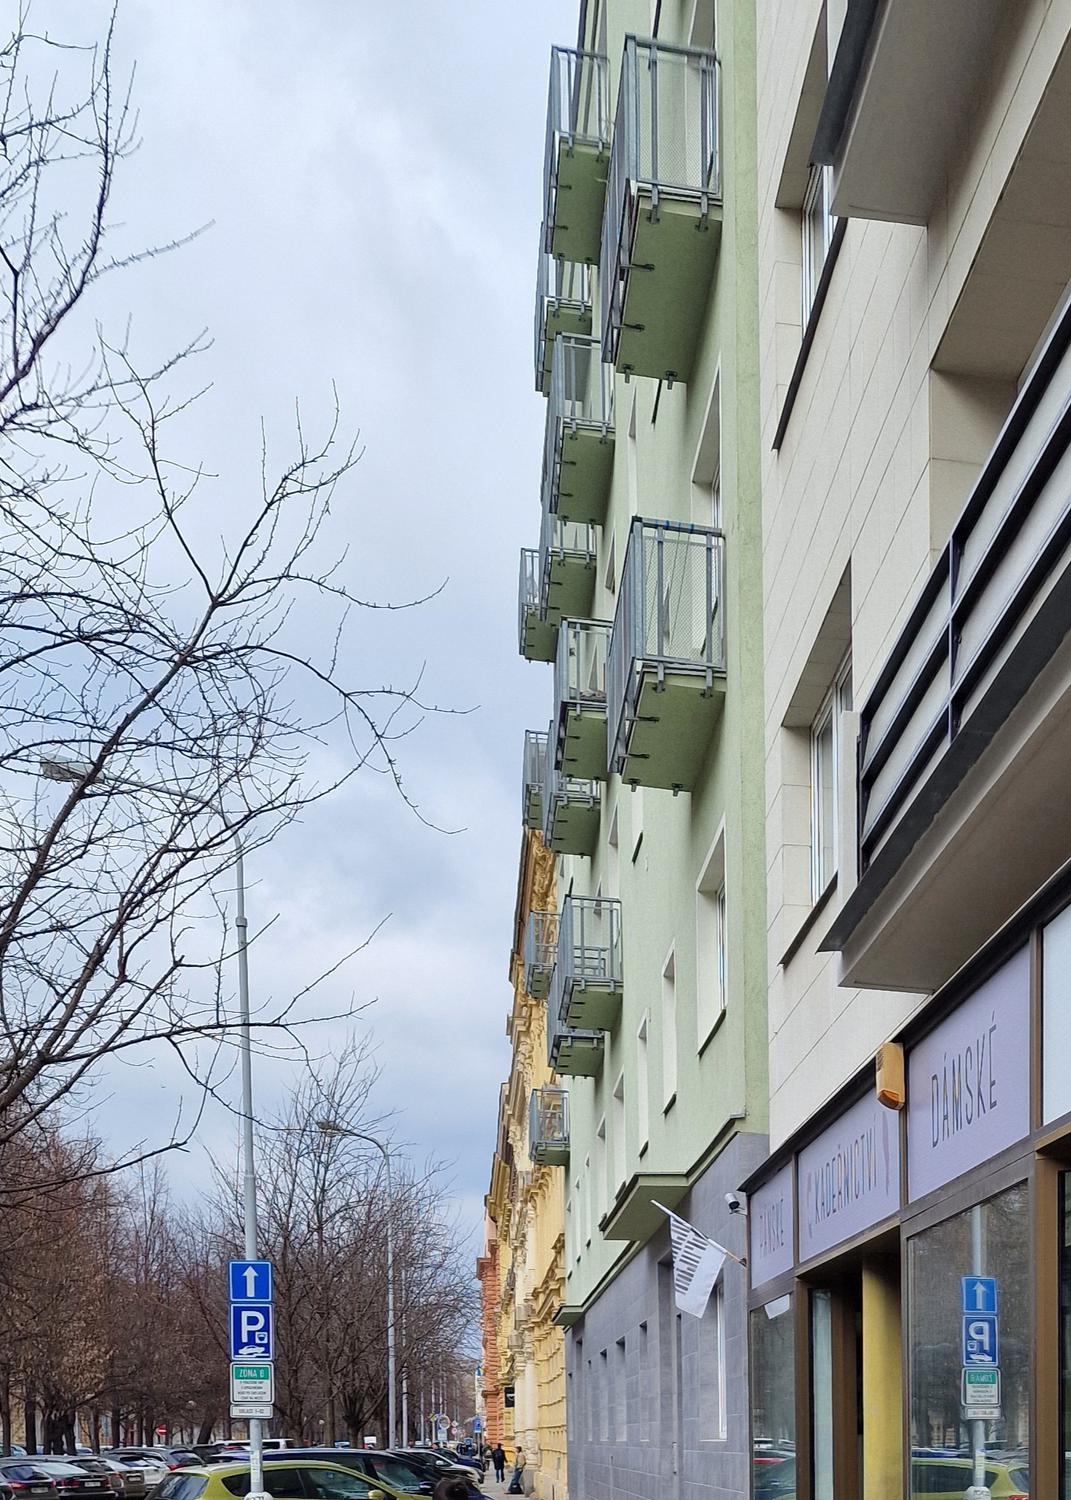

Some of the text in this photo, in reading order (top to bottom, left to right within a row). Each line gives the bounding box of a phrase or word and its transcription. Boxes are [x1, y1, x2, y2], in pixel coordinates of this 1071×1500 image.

[930, 1009, 998, 1149] DÁMSKÉ
[241, 1310, 265, 1343] P
[239, 1368, 258, 1379] ZONA
